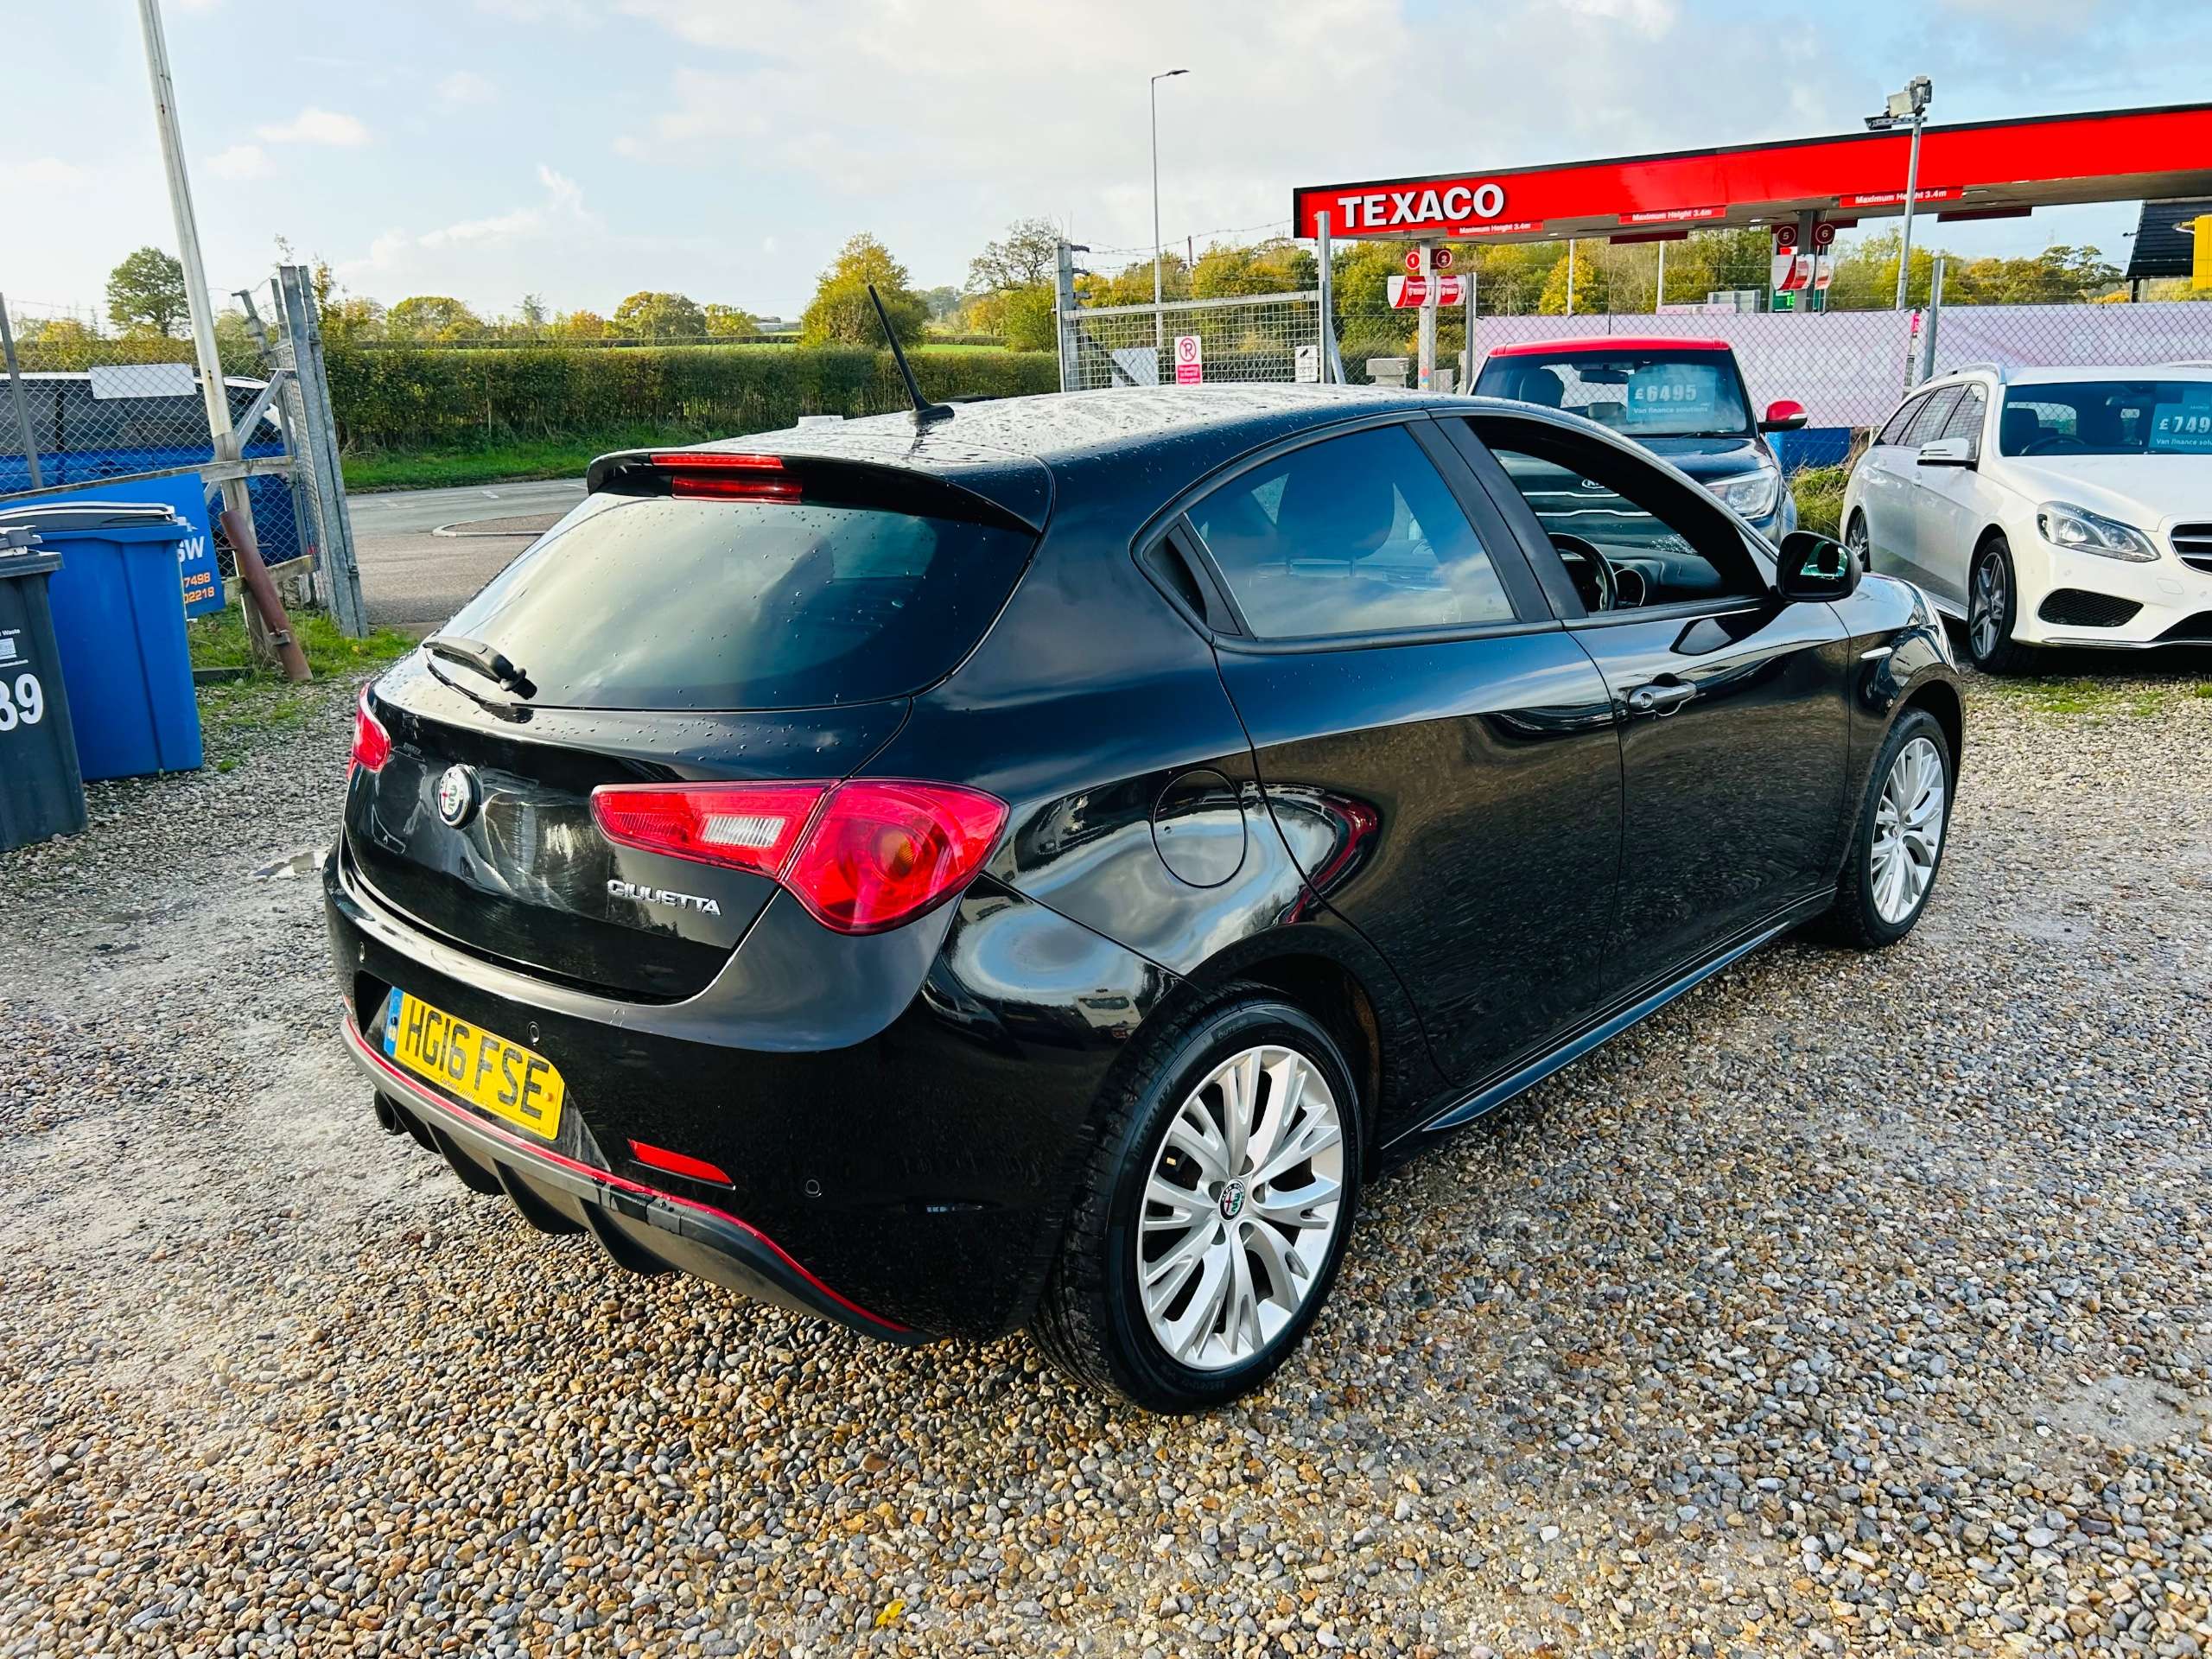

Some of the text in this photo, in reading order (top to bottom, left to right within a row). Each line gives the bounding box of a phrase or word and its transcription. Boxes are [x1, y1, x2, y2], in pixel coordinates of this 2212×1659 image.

[1855, 193, 1894, 203] Maximum
[1925, 189, 1947, 199] 3.4m
[1338, 183, 1504, 228] TEXACO
[1631, 208, 1713, 221] Maximum Height 3.4m
[1459, 225, 1491, 234] Maximum
[1491, 224, 1513, 232] Height
[1821, 230, 1829, 238] 6
[1783, 232, 1789, 240] 5
[1410, 257, 1415, 265] 1
[1440, 255, 1448, 264] 2
[1634, 384, 1697, 403] £6495
[607, 879, 721, 916] GIULIETTA
[405, 999, 550, 1120] HG16 FSE
